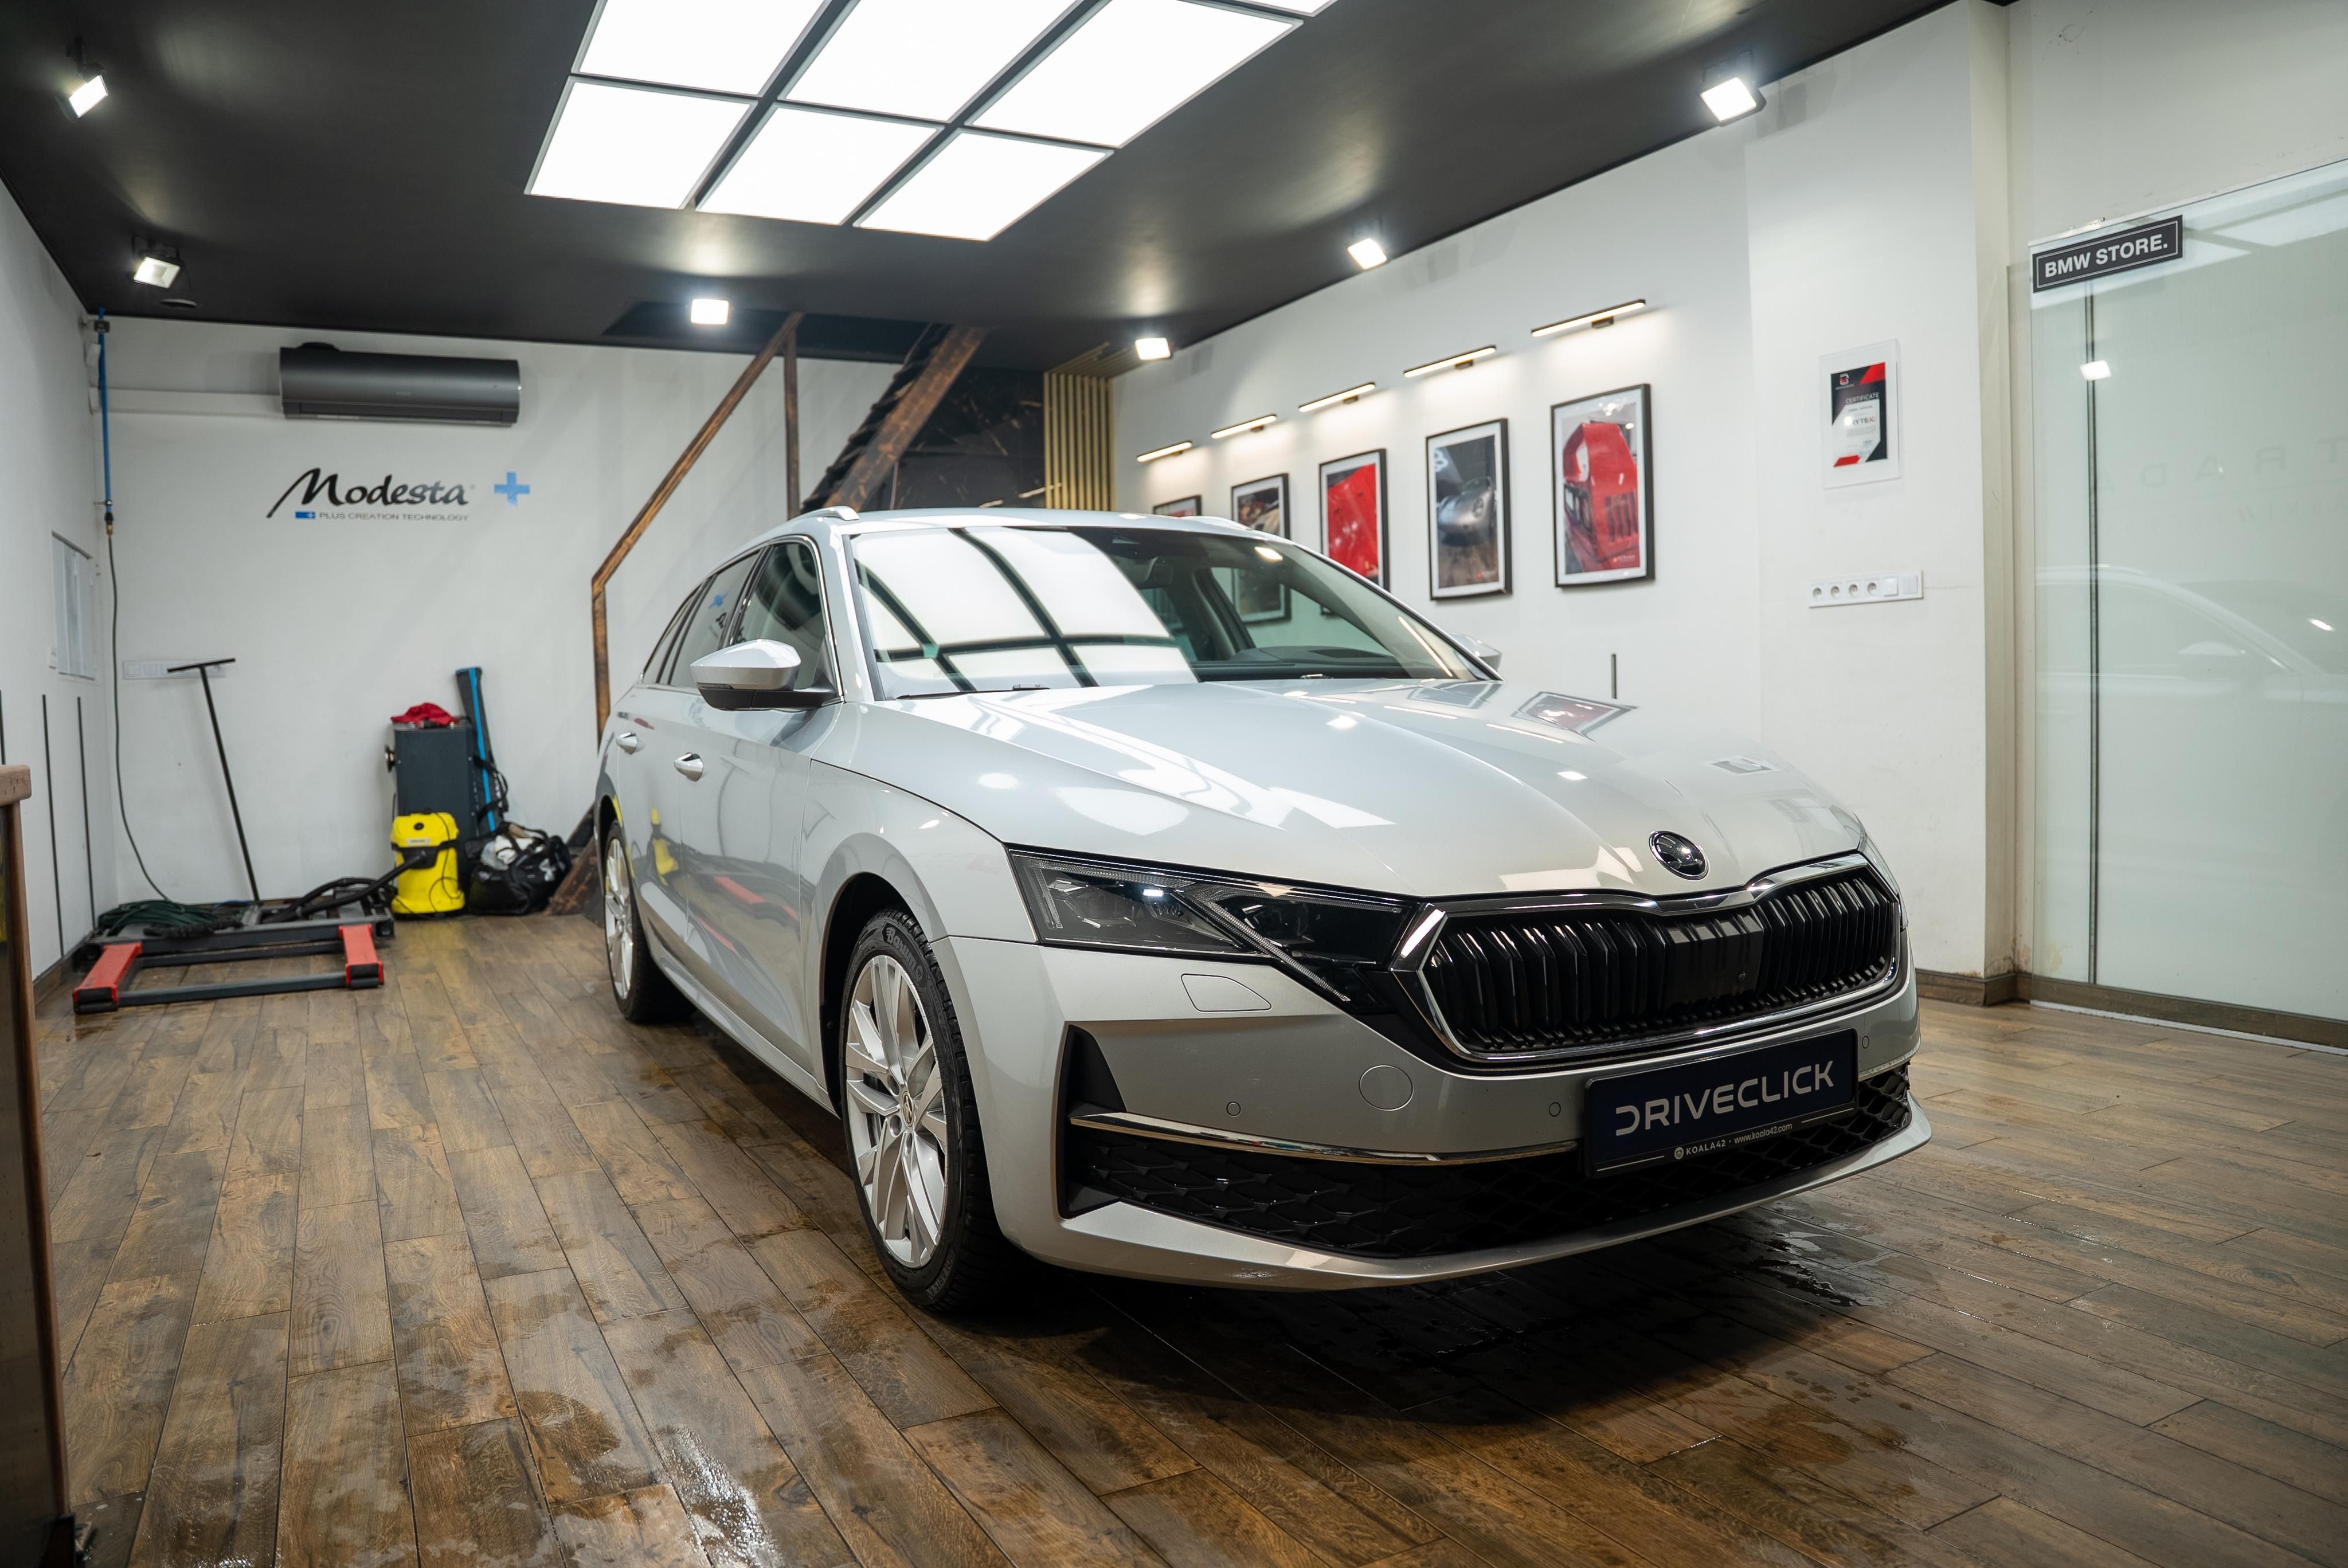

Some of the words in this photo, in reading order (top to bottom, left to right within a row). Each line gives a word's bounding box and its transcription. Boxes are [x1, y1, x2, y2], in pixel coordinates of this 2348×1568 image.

[2045, 253, 2091, 279] BMW
[2095, 234, 2168, 265] STORE.
[1845, 391, 1880, 404] CERTIFICATE
[266, 468, 468, 519] Modesta
[402, 513, 469, 522] TECHNOLOGY
[886, 927, 917, 969] Barum
[1615, 1060, 1834, 1136] DRIVECLICK
[1686, 1139, 1726, 1155] KOALA42
[1733, 1123, 1793, 1144] www.koala42.com
[936, 1252, 954, 1291] POLARIS
